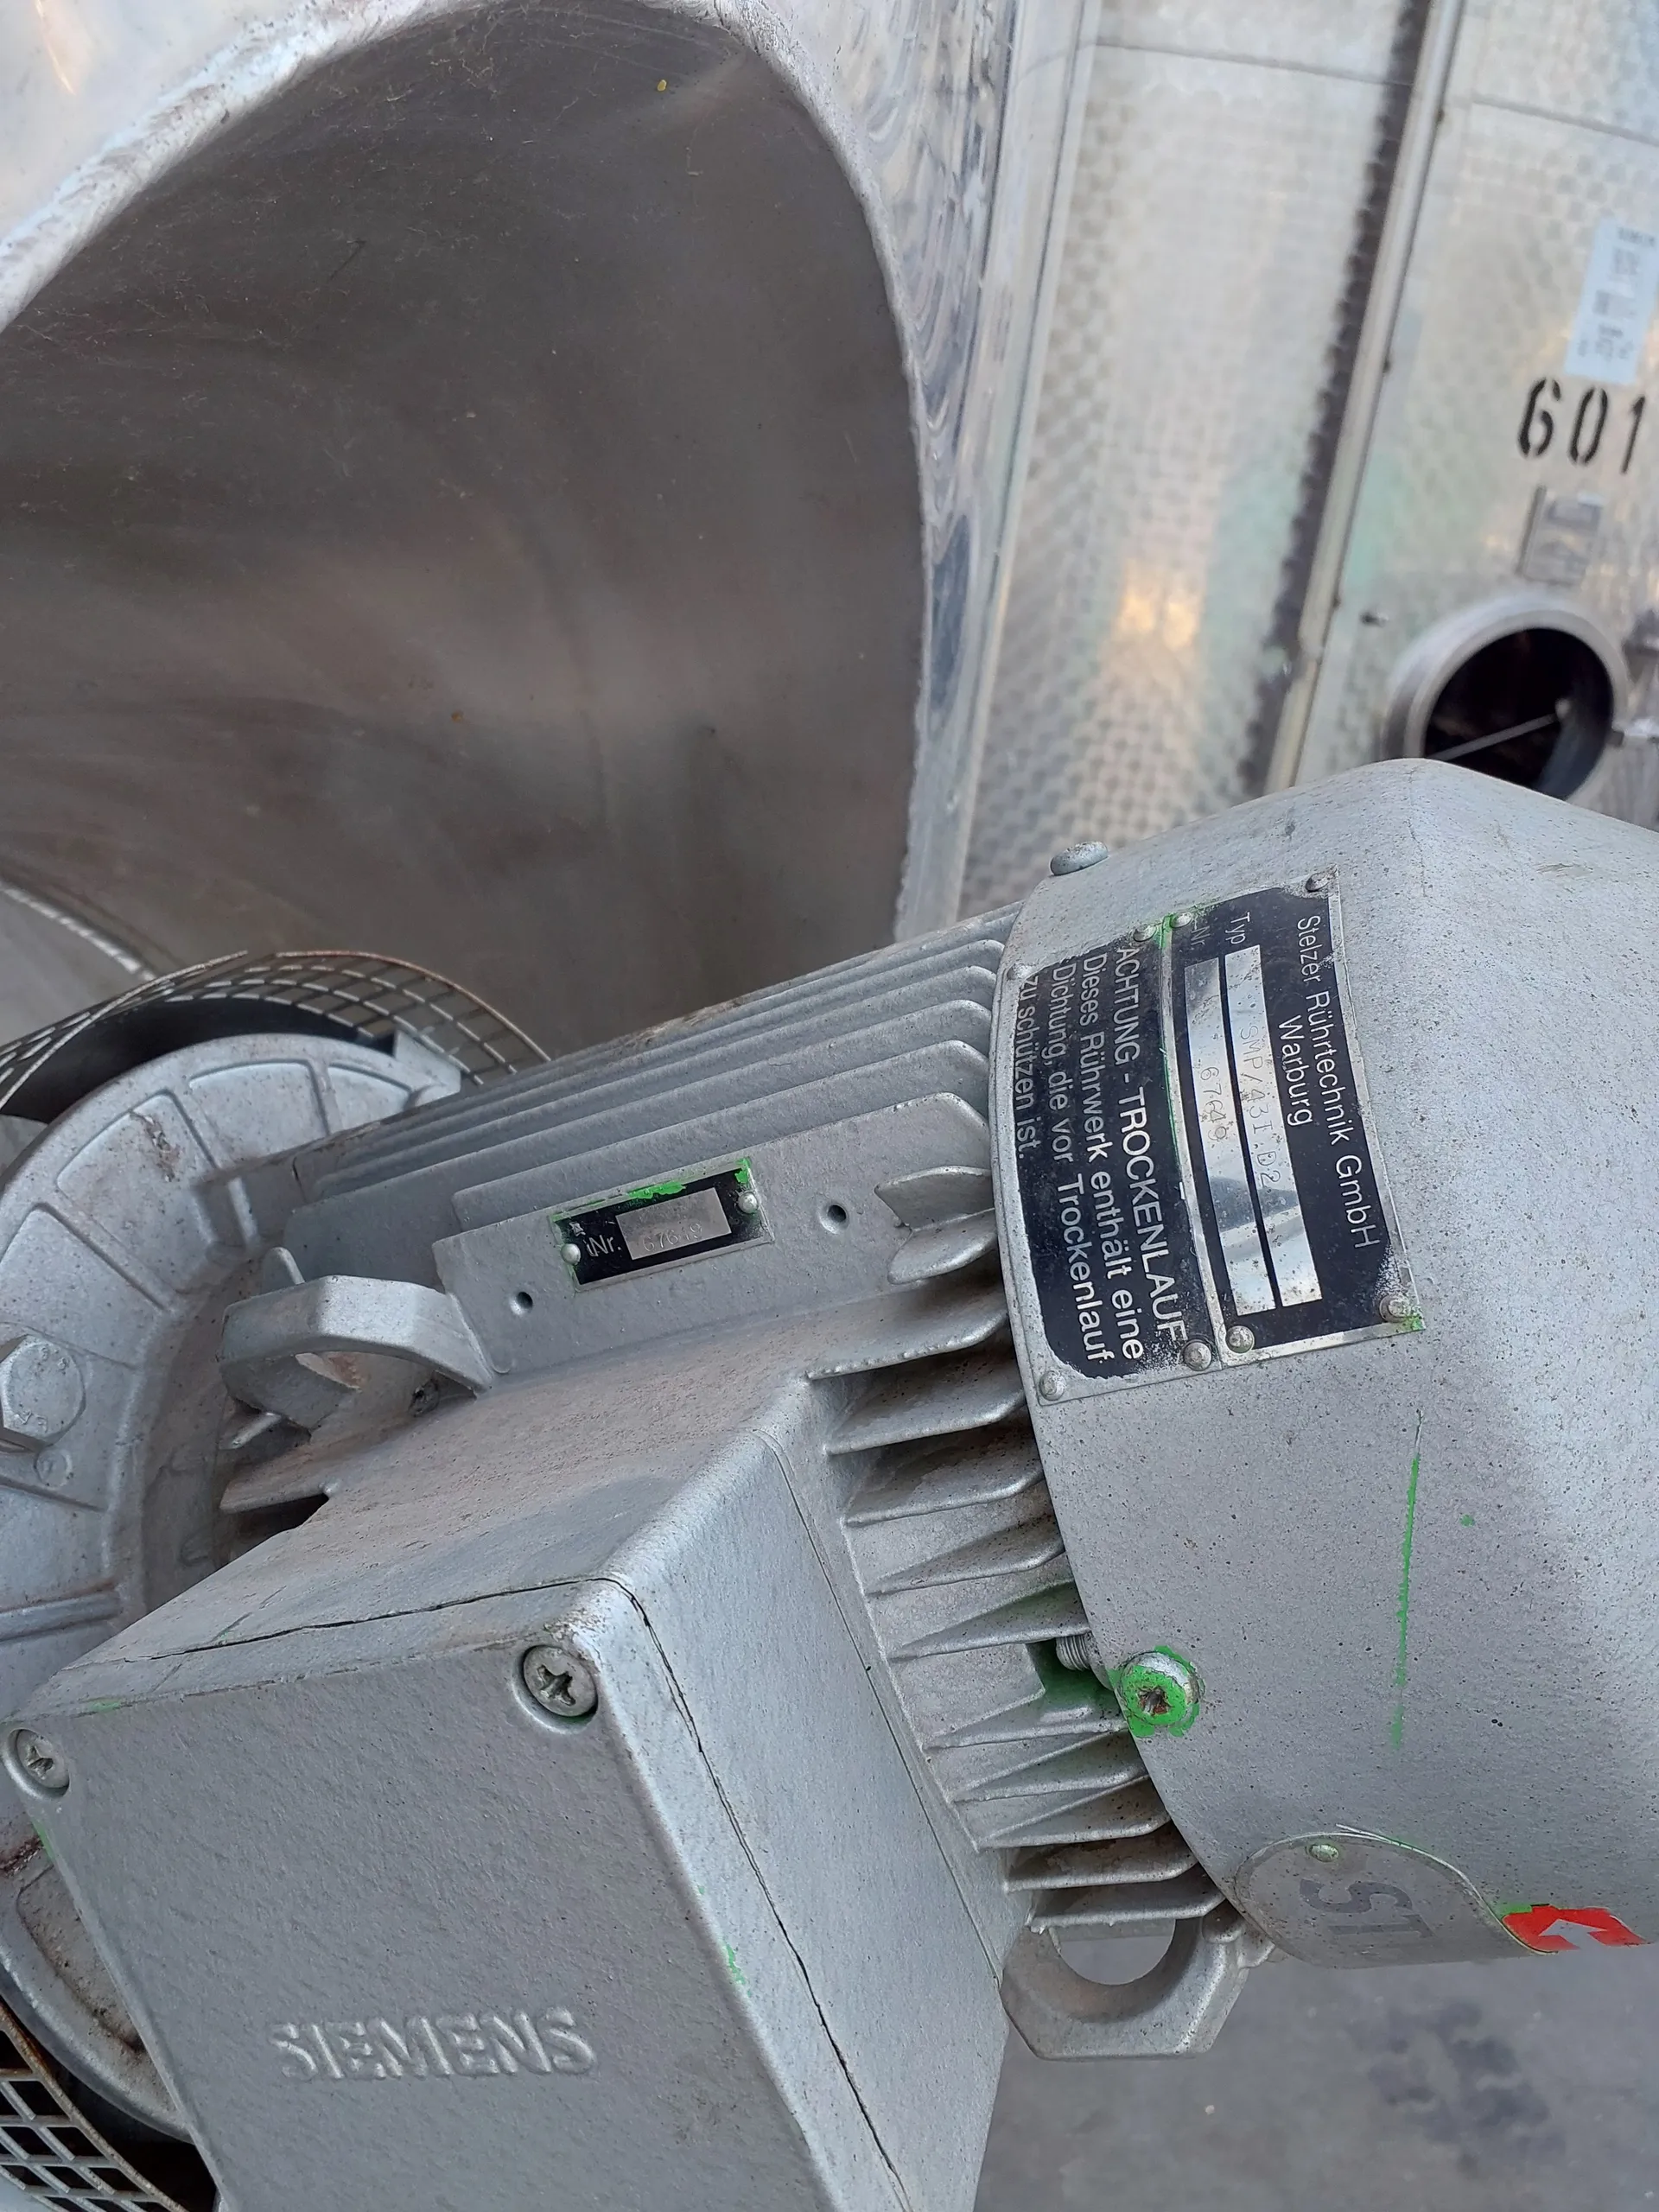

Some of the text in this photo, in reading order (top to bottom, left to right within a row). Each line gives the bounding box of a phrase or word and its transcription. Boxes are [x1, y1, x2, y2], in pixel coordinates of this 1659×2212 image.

[1517, 376, 1646, 475] 601
[1226, 911, 1251, 944] Typ
[1014, 976, 1042, 1160] zu schützen ist.
[1114, 947, 1141, 1065] ACHTUNG
[1277, 1014, 1313, 1127] Warburg
[1079, 953, 1146, 1362] Dieses Rührwerk enthält eine
[1295, 915, 1381, 1249] Stelzer Rührtechnik GmbH
[1040, 963, 1116, 1364] Dichtung, die vor Trockenlauf
[1117, 1087, 1188, 1344] TROCKENLAUF
[268, 2006, 597, 2080] SIEMENS
